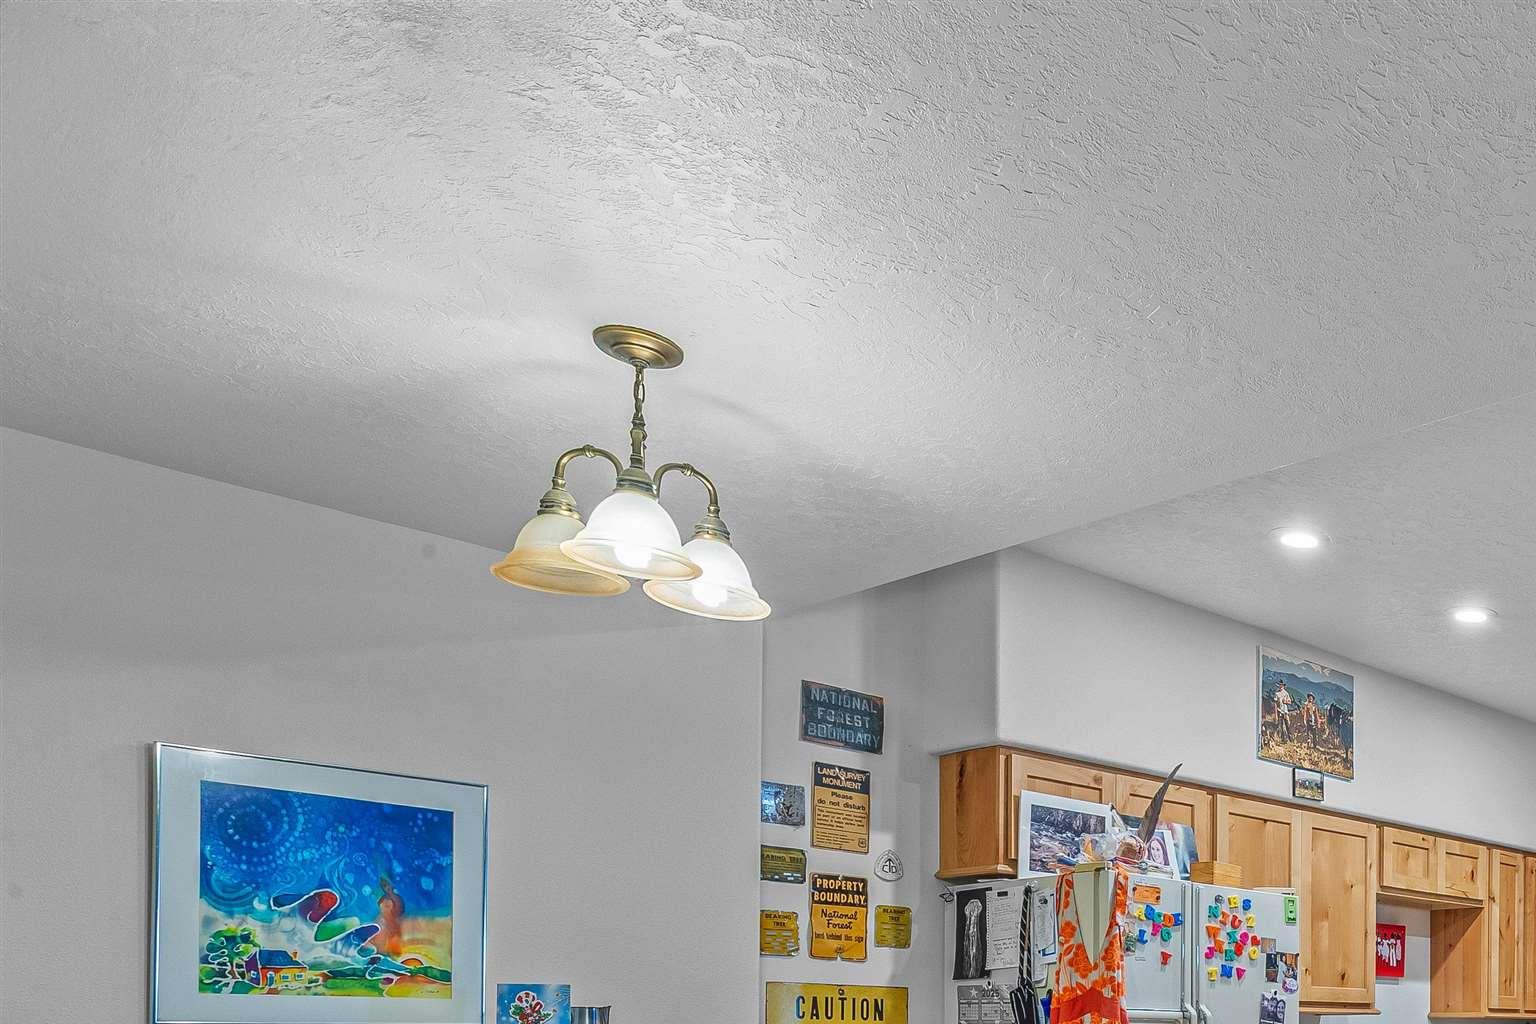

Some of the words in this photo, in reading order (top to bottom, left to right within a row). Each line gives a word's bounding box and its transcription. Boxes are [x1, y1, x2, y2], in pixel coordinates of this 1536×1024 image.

[810, 688, 878, 713] NATIONAL
[817, 707, 870, 728] FOREST
[808, 722, 880, 748] BOUNDARY
[817, 767, 837, 776] LAND
[839, 769, 866, 781] SURVEY
[822, 777, 862, 789] MONUMENT
[831, 791, 853, 800] Please
[843, 802, 866, 811] disturb
[816, 878, 864, 892] PROPERTY
[813, 891, 866, 905] BOUNDARY
[821, 908, 858, 920] National
[826, 919, 853, 929] Forest
[982, 989, 1000, 998] 2025
[795, 995, 884, 1021] CAUTION
